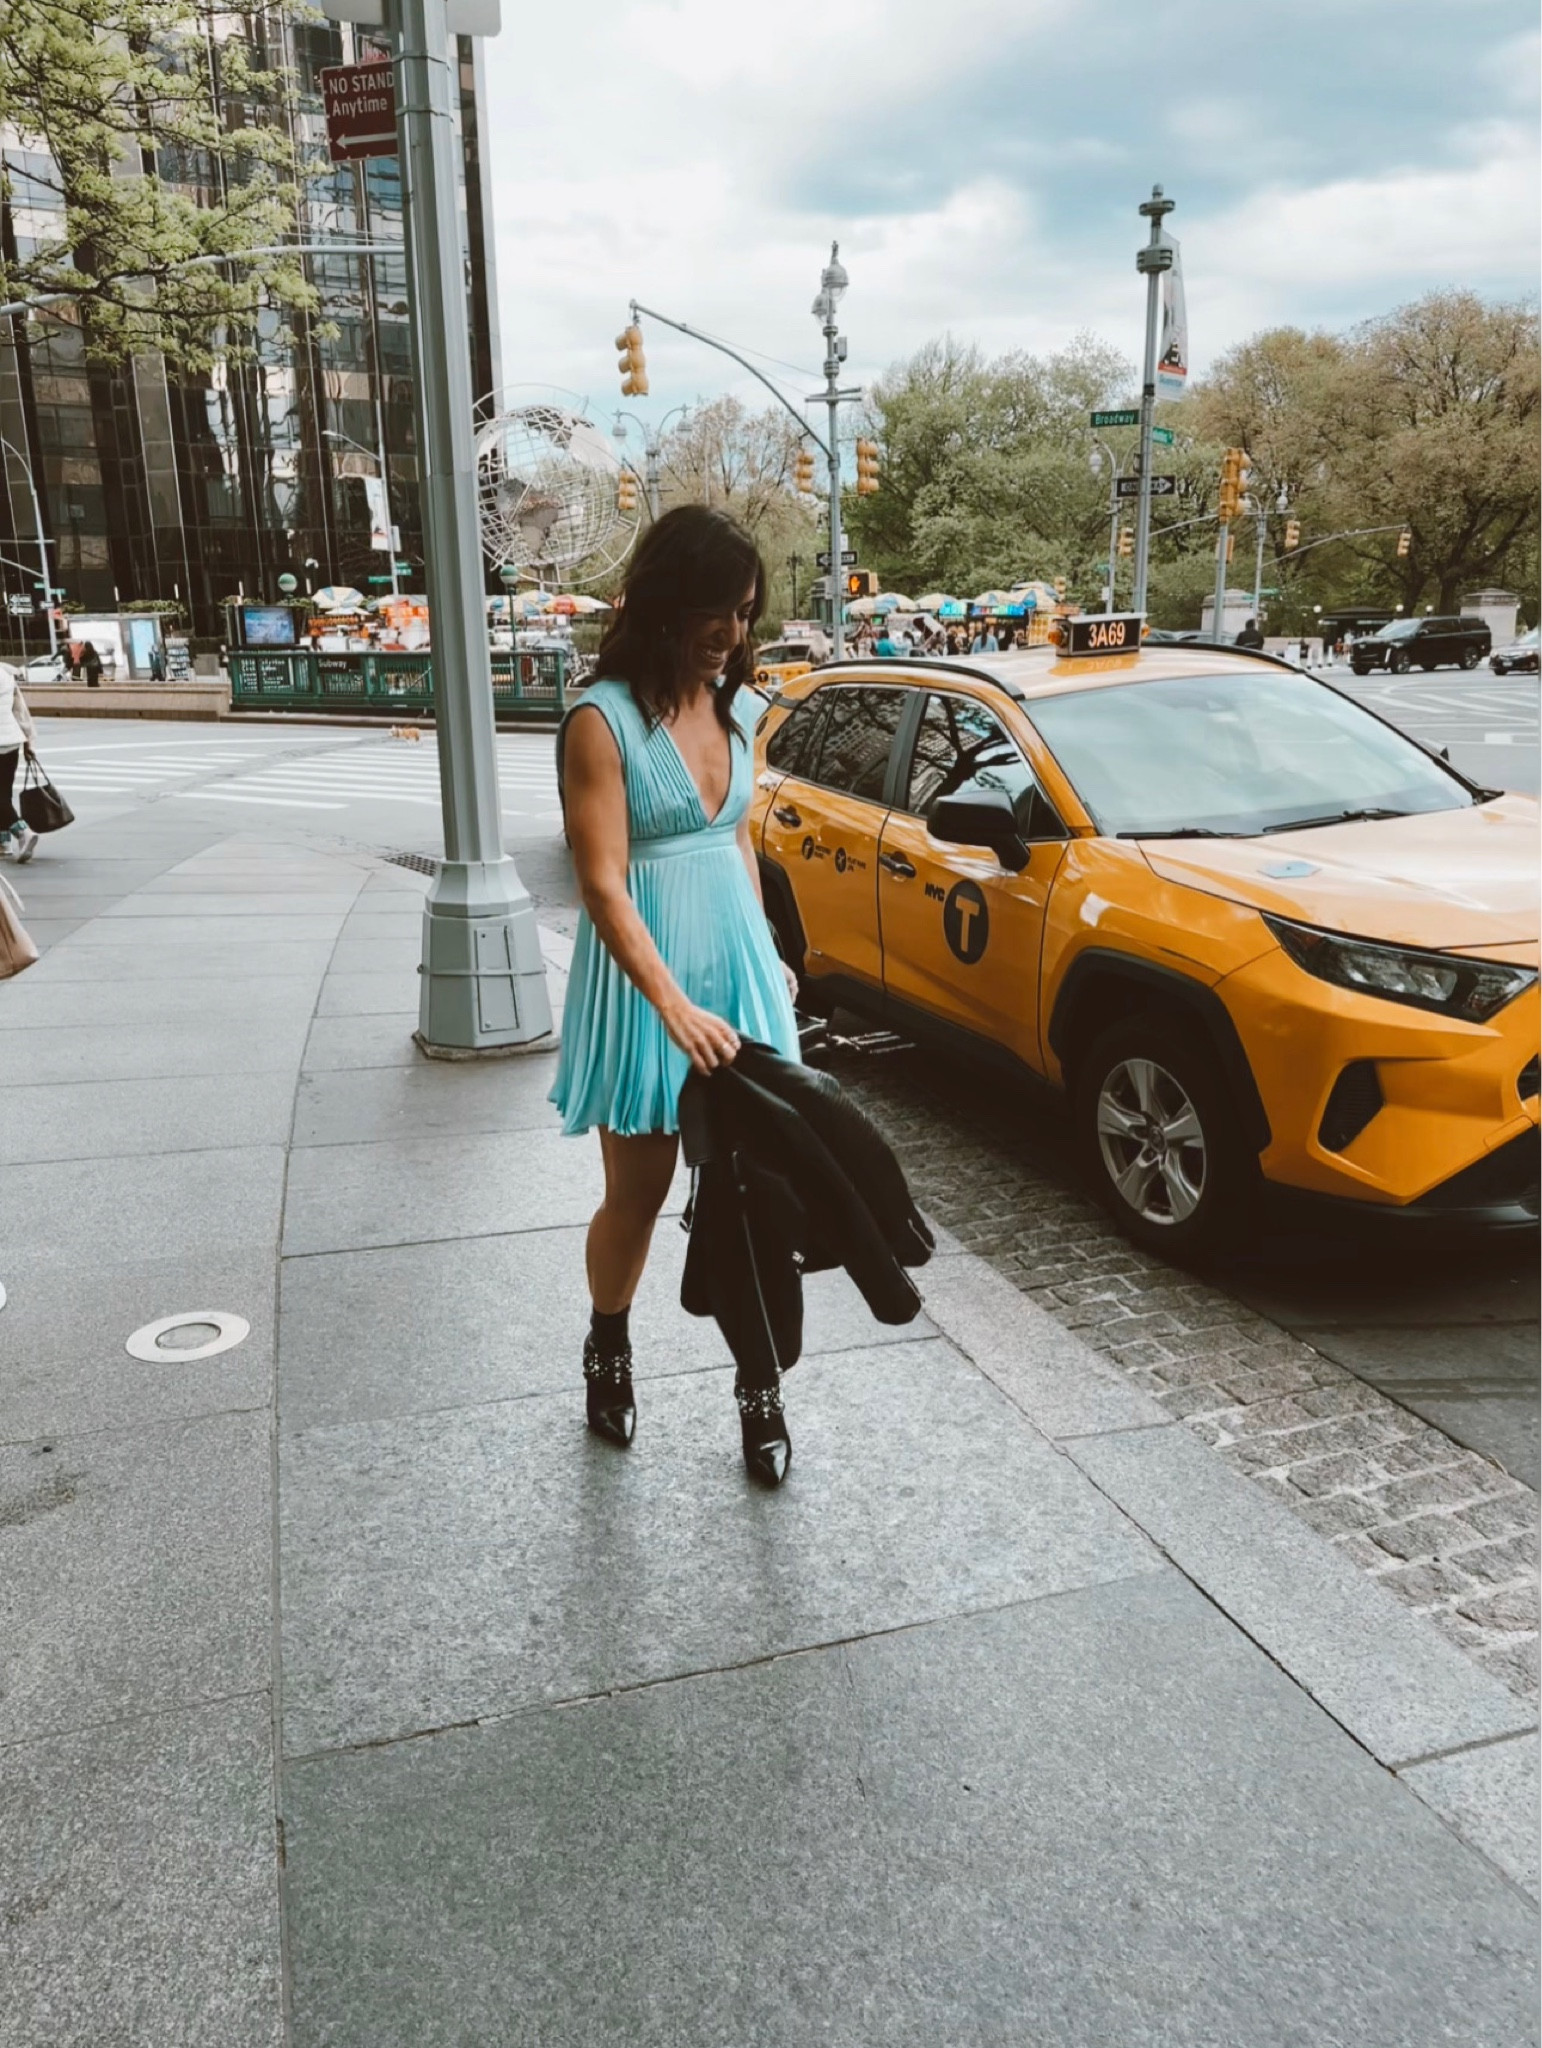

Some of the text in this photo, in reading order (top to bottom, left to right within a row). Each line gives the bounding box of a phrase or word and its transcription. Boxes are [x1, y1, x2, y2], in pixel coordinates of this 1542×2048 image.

[329, 71, 394, 95] NO STAND
[332, 96, 388, 119] Anytime
[1095, 412, 1135, 425] Broadway
[1088, 621, 1126, 648] 3A69
[318, 658, 347, 670] Subway
[925, 882, 980, 953] NYC T
